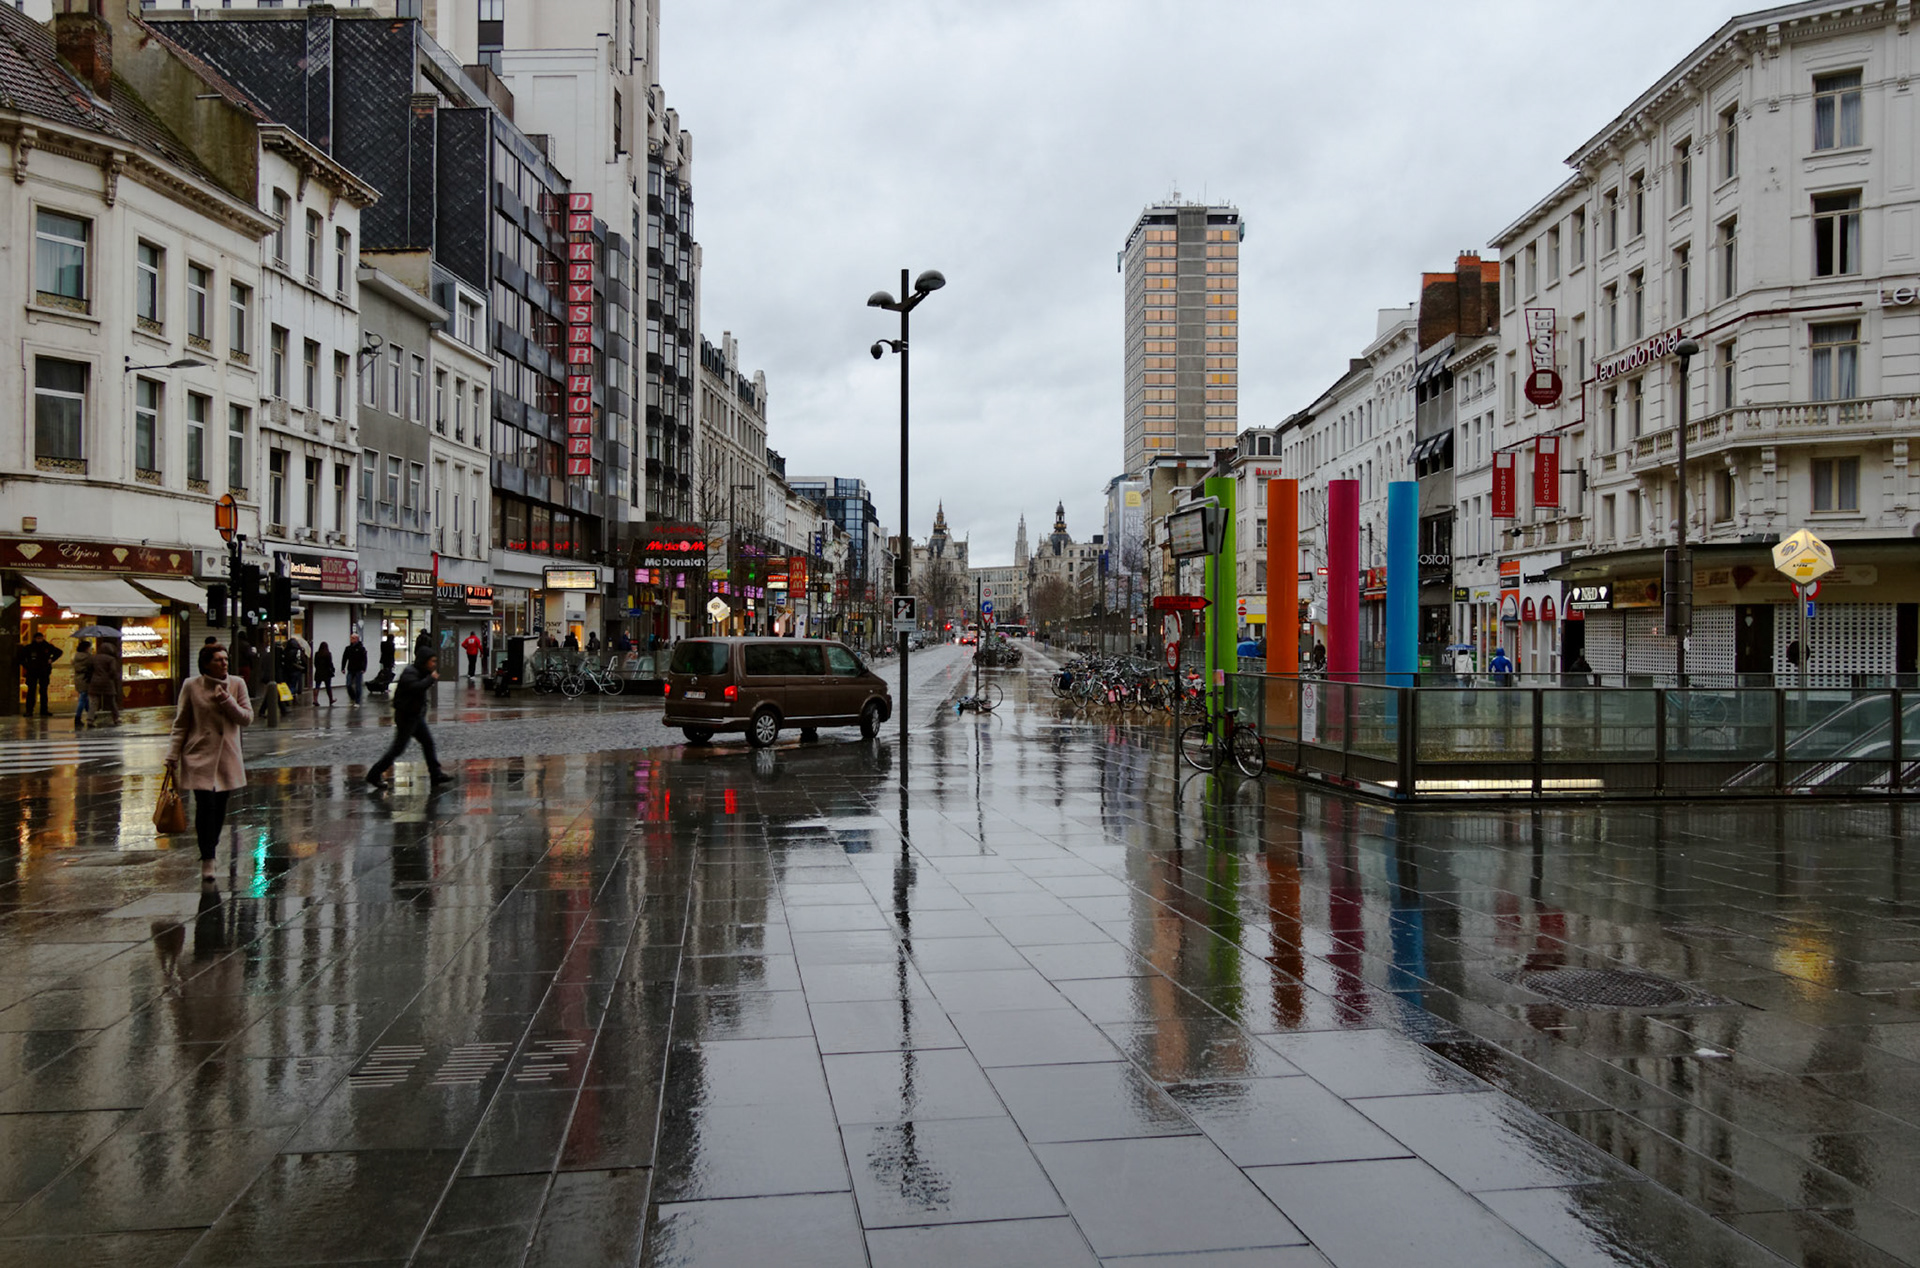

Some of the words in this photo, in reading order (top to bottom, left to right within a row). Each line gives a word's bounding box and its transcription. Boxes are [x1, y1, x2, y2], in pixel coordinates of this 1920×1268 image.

[572, 243, 591, 363] KEYSER
[1596, 346, 1648, 382] Leonardo
[1648, 328, 1682, 361] Hotel
[571, 376, 590, 474] HOTEL
[405, 571, 431, 584] JENNY
